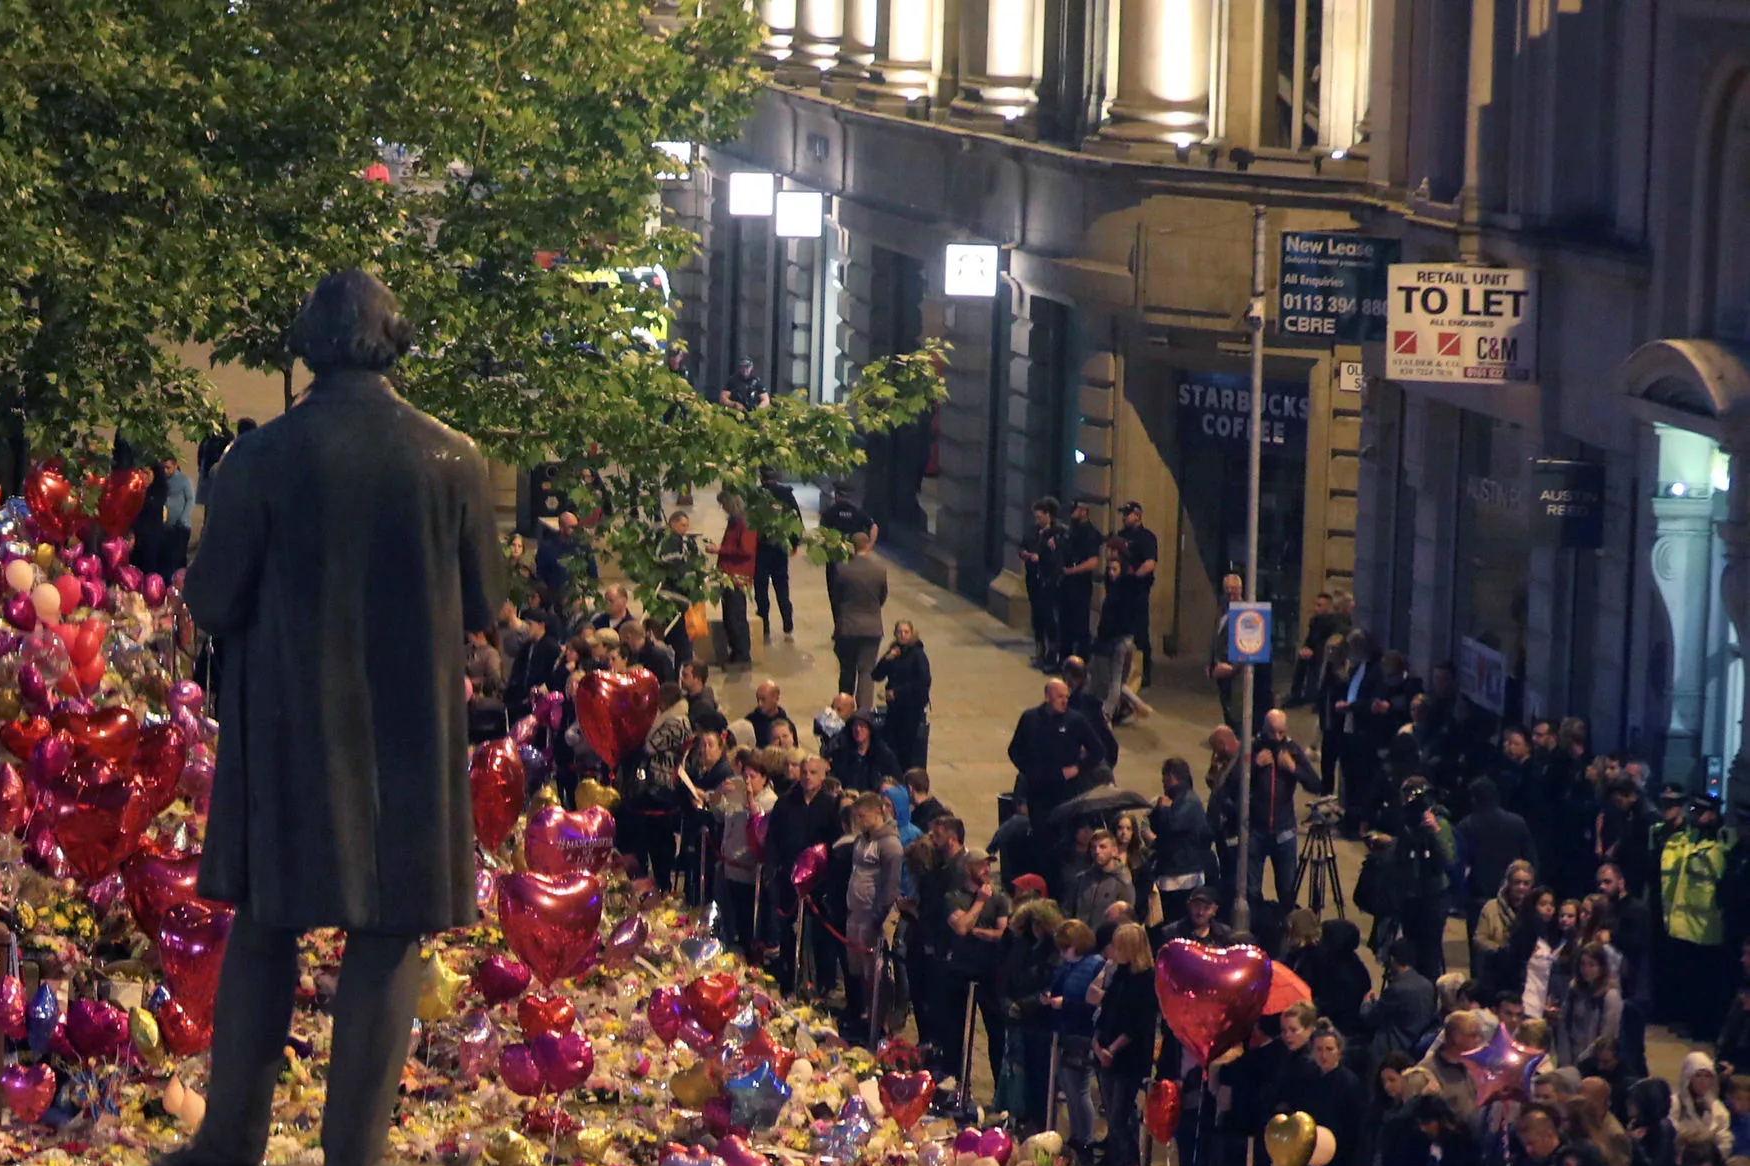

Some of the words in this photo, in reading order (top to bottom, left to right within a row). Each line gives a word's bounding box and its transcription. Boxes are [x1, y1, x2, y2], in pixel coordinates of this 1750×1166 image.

[1286, 236, 1324, 254] New
[1328, 238, 1374, 257] Lease
[1284, 273, 1297, 285] All
[1300, 274, 1345, 288] Enquiries
[1417, 271, 1468, 285] RETAIL
[1473, 273, 1510, 286] UNIT
[1283, 293, 1324, 312] 0113
[1328, 295, 1358, 315] 394
[1397, 286, 1448, 314] TO
[1462, 288, 1529, 317] LET
[1284, 316, 1336, 334] CBRE
[1429, 318, 1445, 327] ALL
[1448, 319, 1495, 329] ENQUIRIES
[1477, 336, 1518, 361] C&M
[1346, 364, 1361, 376] OL
[1539, 489, 1598, 502] AUSTIN
[1546, 504, 1589, 516] REED
